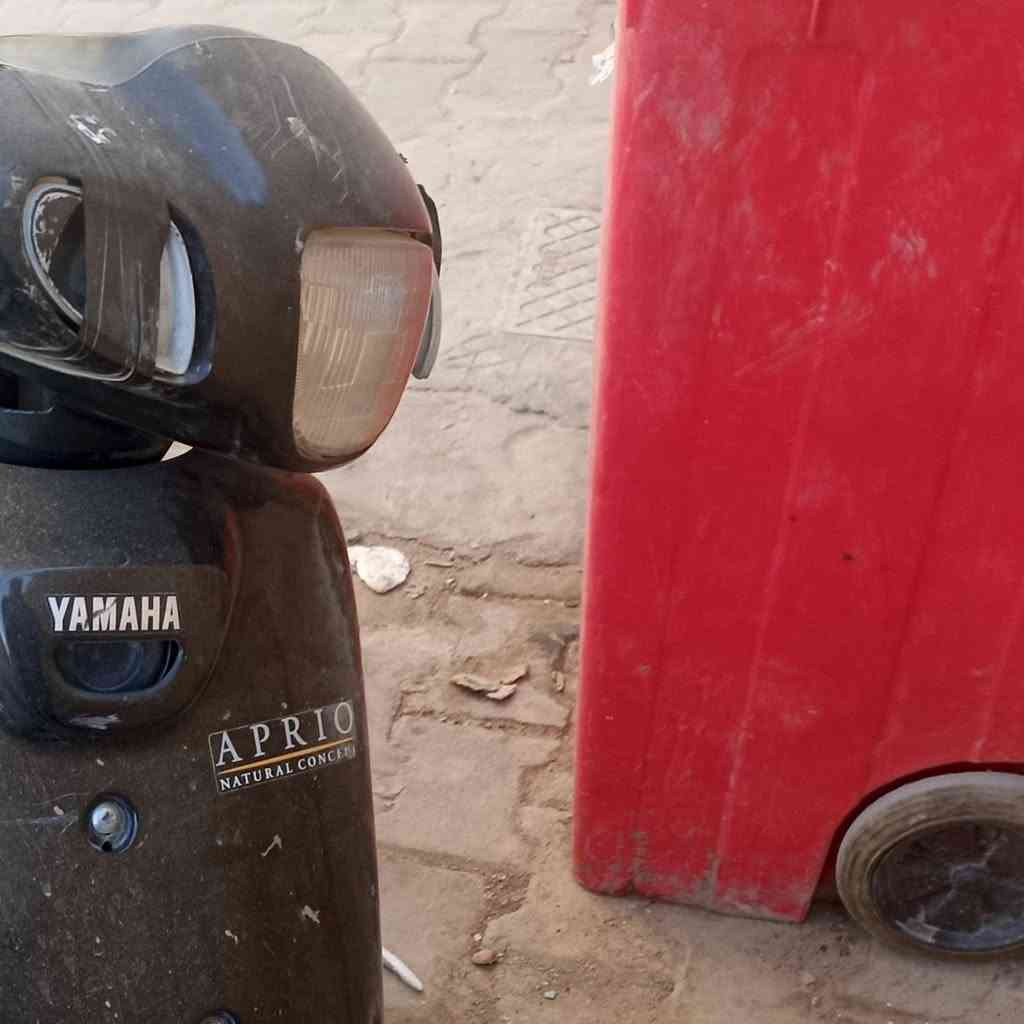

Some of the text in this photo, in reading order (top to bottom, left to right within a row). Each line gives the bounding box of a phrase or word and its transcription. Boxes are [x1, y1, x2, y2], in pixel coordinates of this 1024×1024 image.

[48, 596, 180, 631] YAMAHA
[216, 702, 354, 767] APRIO
[220, 763, 294, 792] NATURAL
